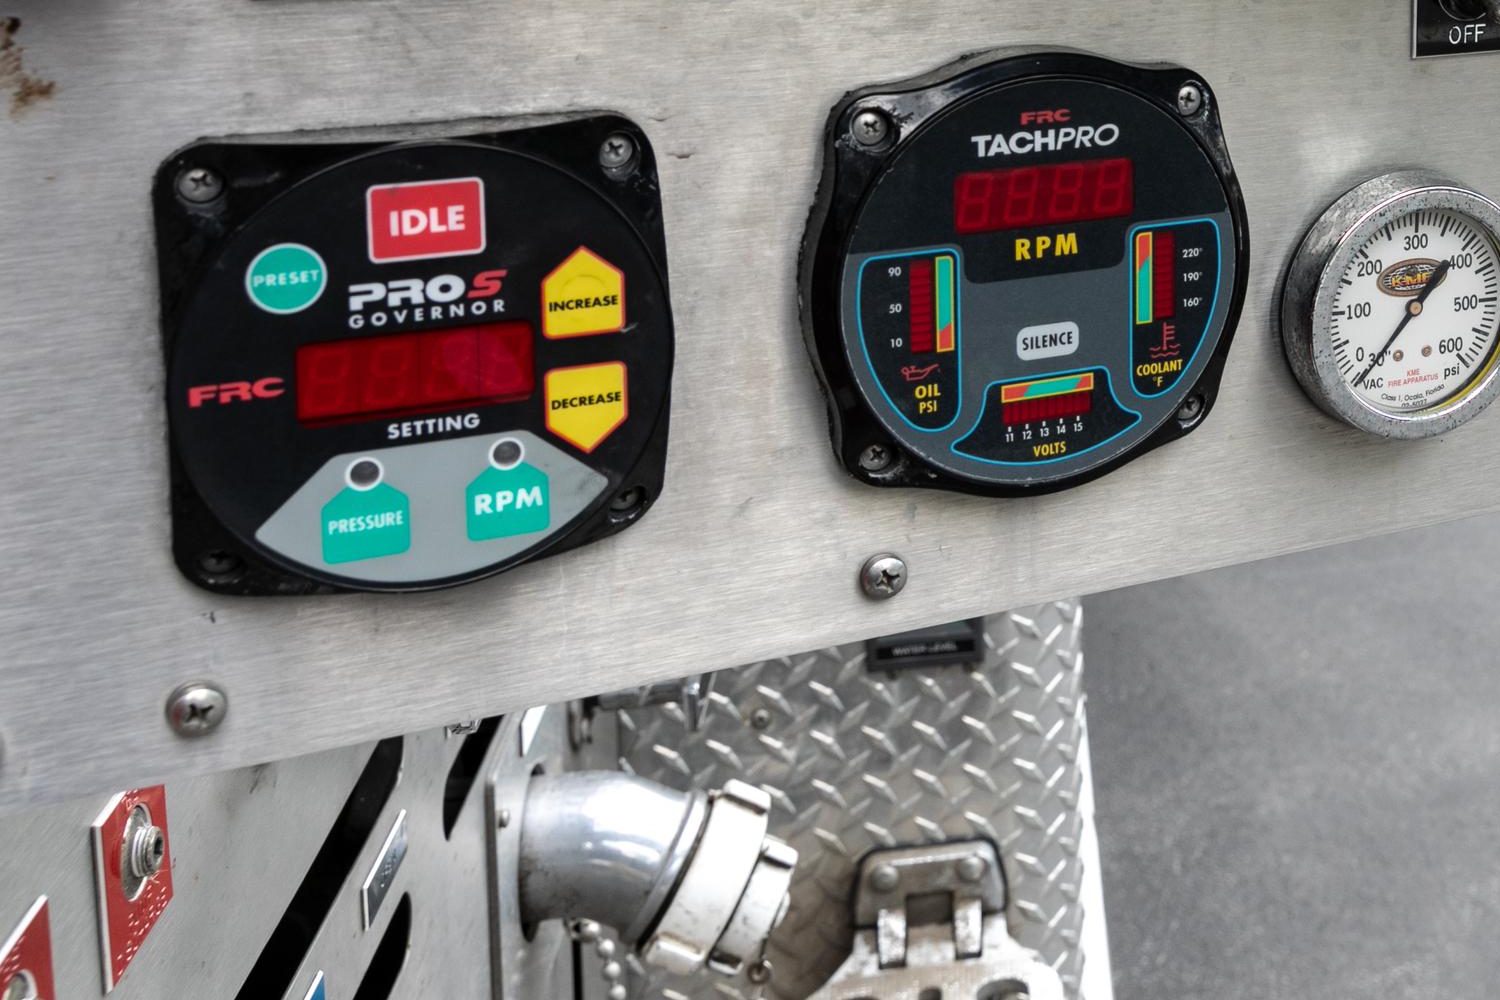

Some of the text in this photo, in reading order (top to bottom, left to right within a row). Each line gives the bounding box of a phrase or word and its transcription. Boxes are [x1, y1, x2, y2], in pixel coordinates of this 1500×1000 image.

[1448, 23, 1486, 44] OFF
[1020, 108, 1071, 126] FRC
[971, 122, 1119, 159] TACHPRO
[388, 204, 466, 238] IDLE
[1014, 232, 1079, 261] RPM
[1404, 233, 1428, 251] 300
[1357, 258, 1383, 277] 200
[1449, 252, 1473, 270] 400
[252, 268, 320, 287] PRESET
[888, 266, 902, 278] 90
[548, 294, 619, 314] INCREASE
[888, 303, 903, 314] 50
[1346, 302, 1371, 320] 100
[1454, 294, 1478, 312] 500
[348, 299, 505, 330] GOVERNOR
[890, 337, 903, 349] 10
[1021, 330, 1074, 351] SILENCE
[1439, 336, 1463, 355] 600
[1355, 347, 1364, 362] 0
[1136, 358, 1183, 378] COOLANT
[1406, 368, 1420, 377] KME
[1443, 362, 1460, 380] psi
[1363, 377, 1384, 390] VAC
[1387, 373, 1439, 388] FIRE APPARATUS
[188, 376, 286, 408] FRC
[914, 383, 941, 400] OIL
[550, 391, 622, 412] DECREASE
[919, 399, 938, 416] PSI
[387, 413, 480, 441] SETTING
[1005, 421, 1084, 443] 11 12 13 14 15
[1033, 441, 1067, 457] VOLTS
[474, 487, 543, 516] RPM
[327, 510, 404, 536] PRESSURE
